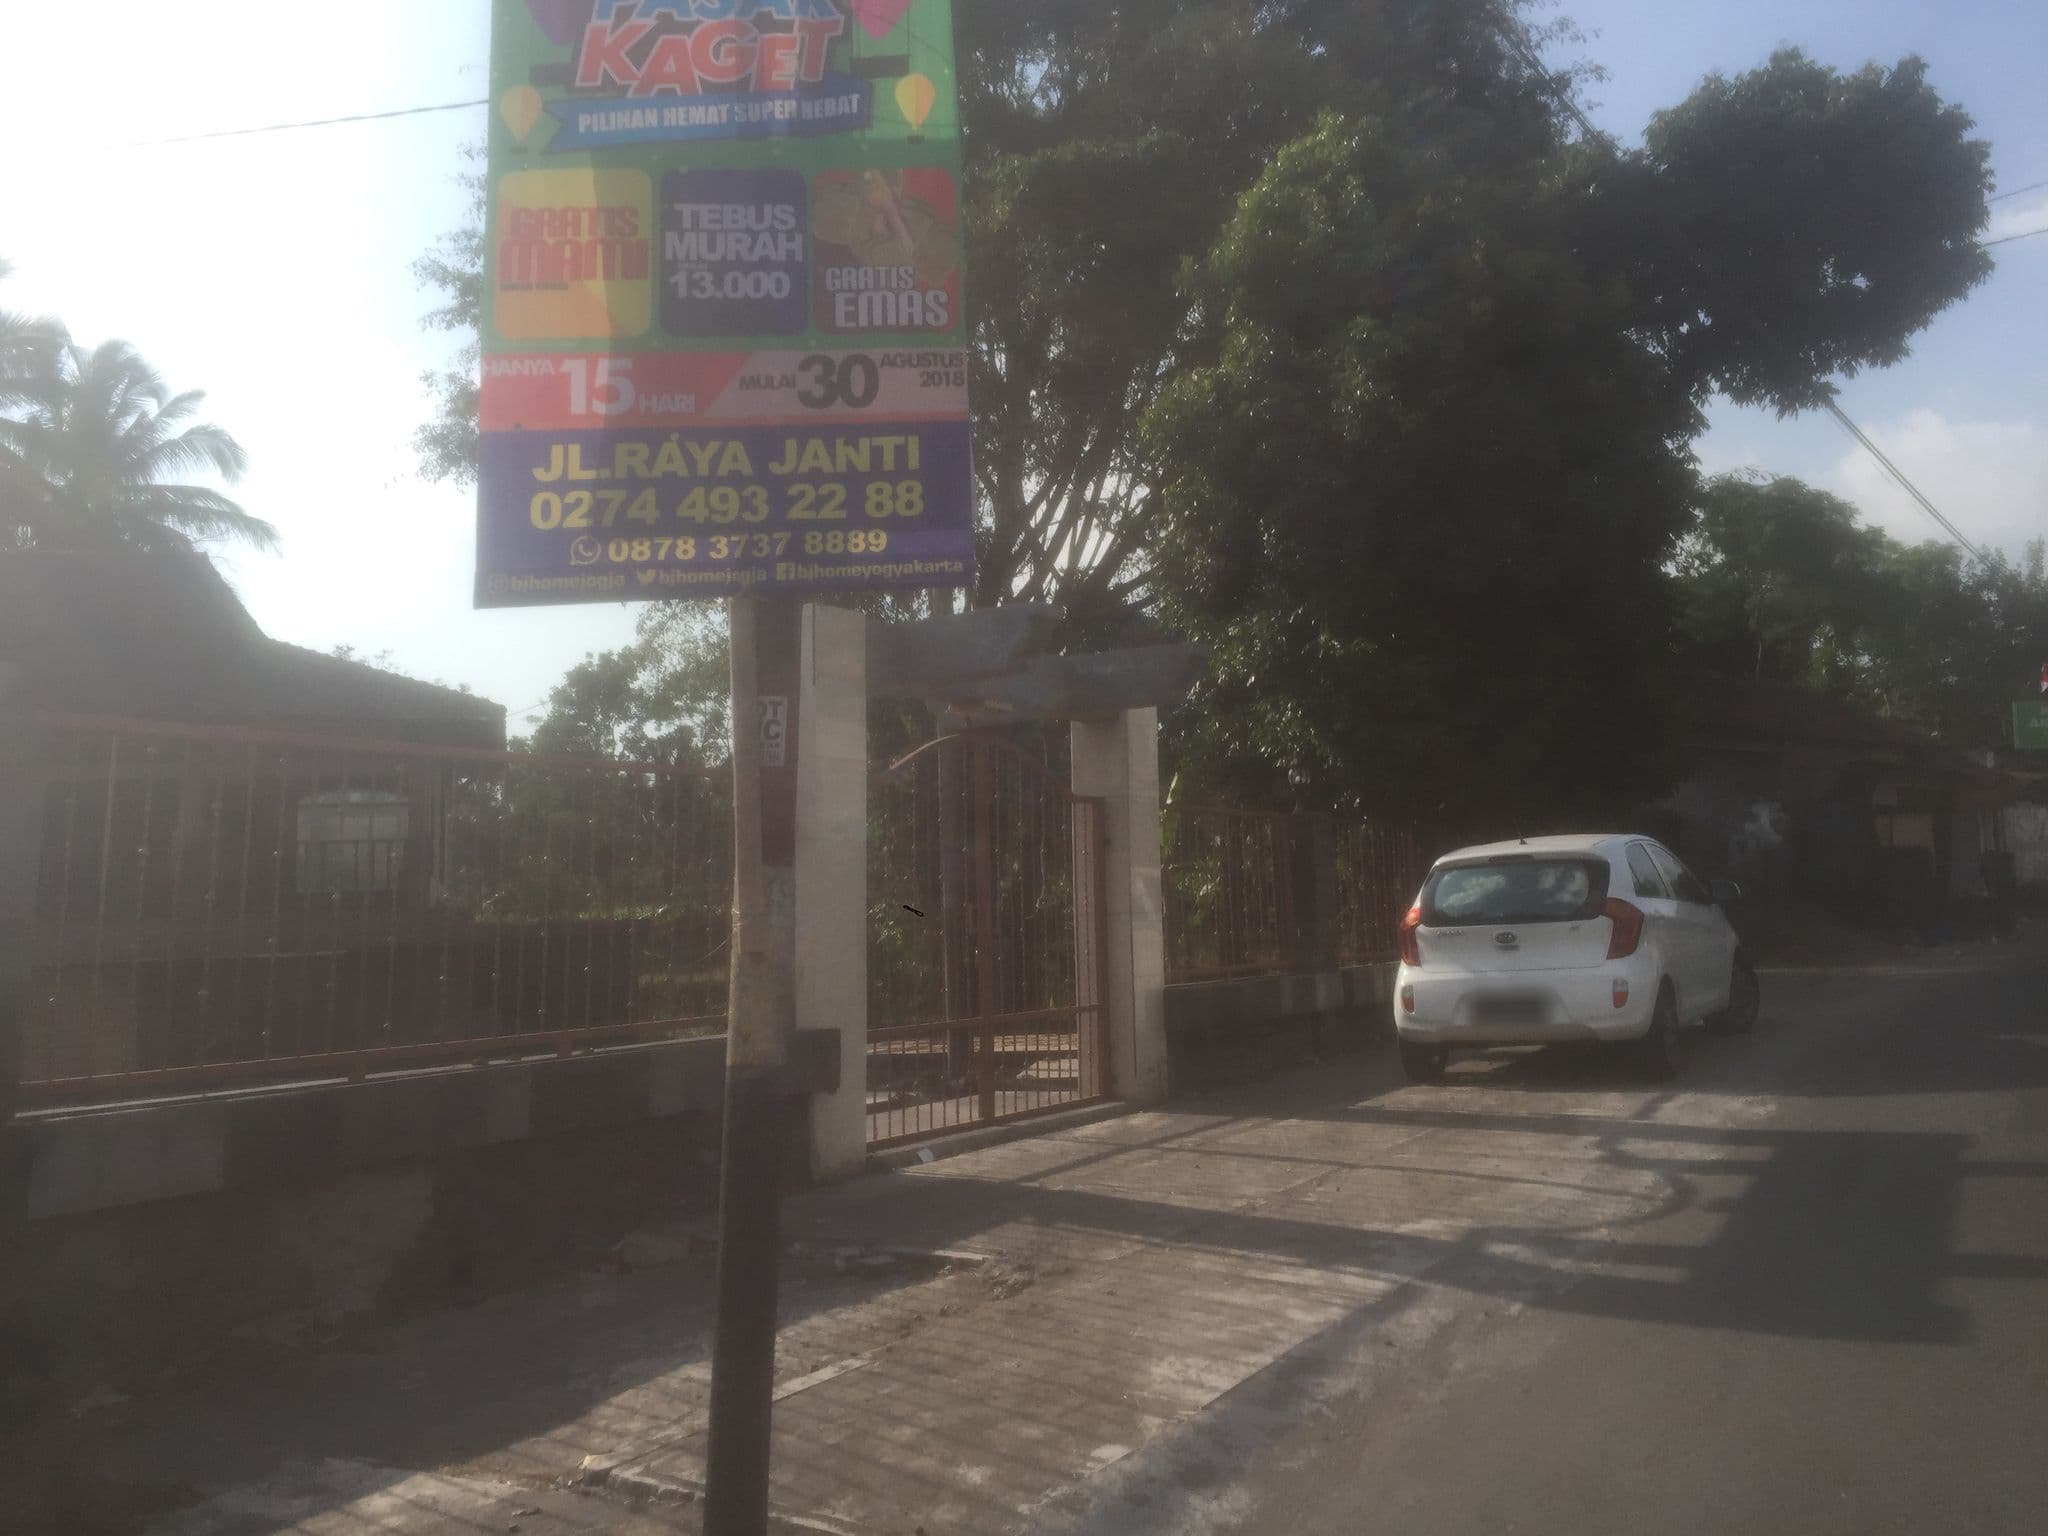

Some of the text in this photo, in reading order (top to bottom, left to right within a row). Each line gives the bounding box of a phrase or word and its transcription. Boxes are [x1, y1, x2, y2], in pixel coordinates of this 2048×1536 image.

[576, 14, 844, 97] KAGET
[578, 94, 861, 133] PILIHAN HEMAT SUPER HEBAT
[510, 206, 639, 239] GRATIS
[674, 203, 796, 232] TEBUS
[664, 231, 803, 263] MURAH
[669, 270, 791, 300] 13.000
[825, 266, 914, 290] GRATIS
[834, 288, 950, 328] EMAS
[481, 354, 555, 377] HANYA
[880, 349, 965, 369] AGUSTUS
[559, 356, 635, 415] 15
[738, 372, 797, 391] MULAI
[797, 353, 880, 410] 30
[919, 369, 966, 389] 2018
[638, 391, 696, 415] HARI
[768, 435, 920, 474] JANTI
[529, 479, 925, 530] 0274 493 22 88
[608, 528, 889, 563] 0878 3737 8889
